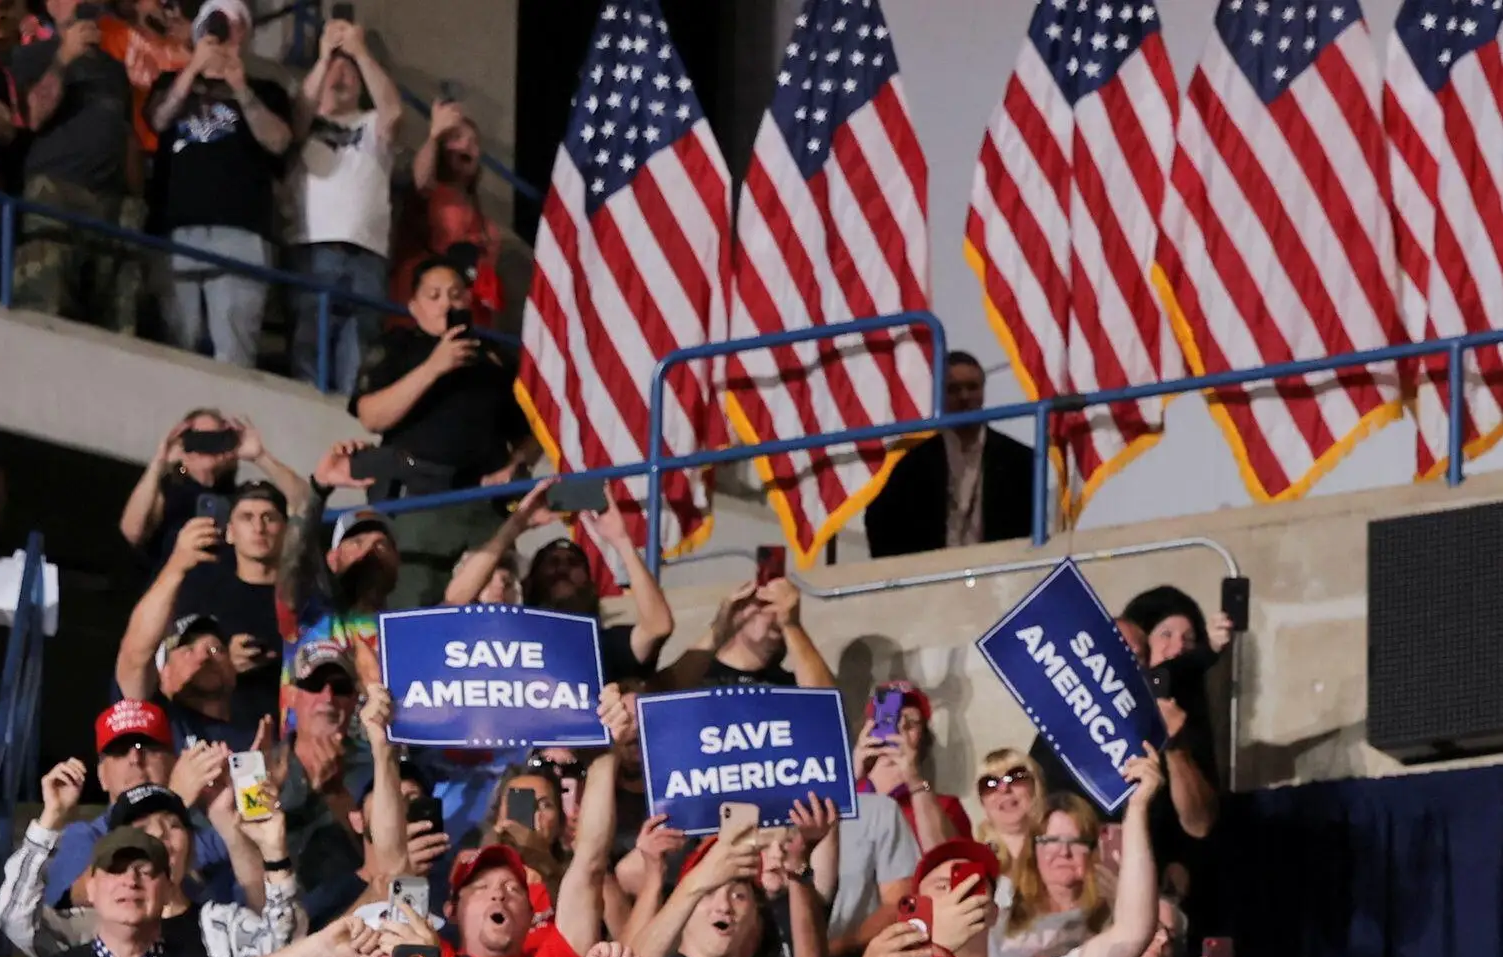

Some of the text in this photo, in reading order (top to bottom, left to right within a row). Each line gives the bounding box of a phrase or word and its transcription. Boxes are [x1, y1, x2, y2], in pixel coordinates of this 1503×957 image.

[444, 640, 545, 669] SAVE
[1069, 630, 1138, 719] SAVE
[403, 679, 590, 710] AMERICA!
[699, 720, 794, 755] SAVE
[664, 755, 837, 799] AMERICA!
